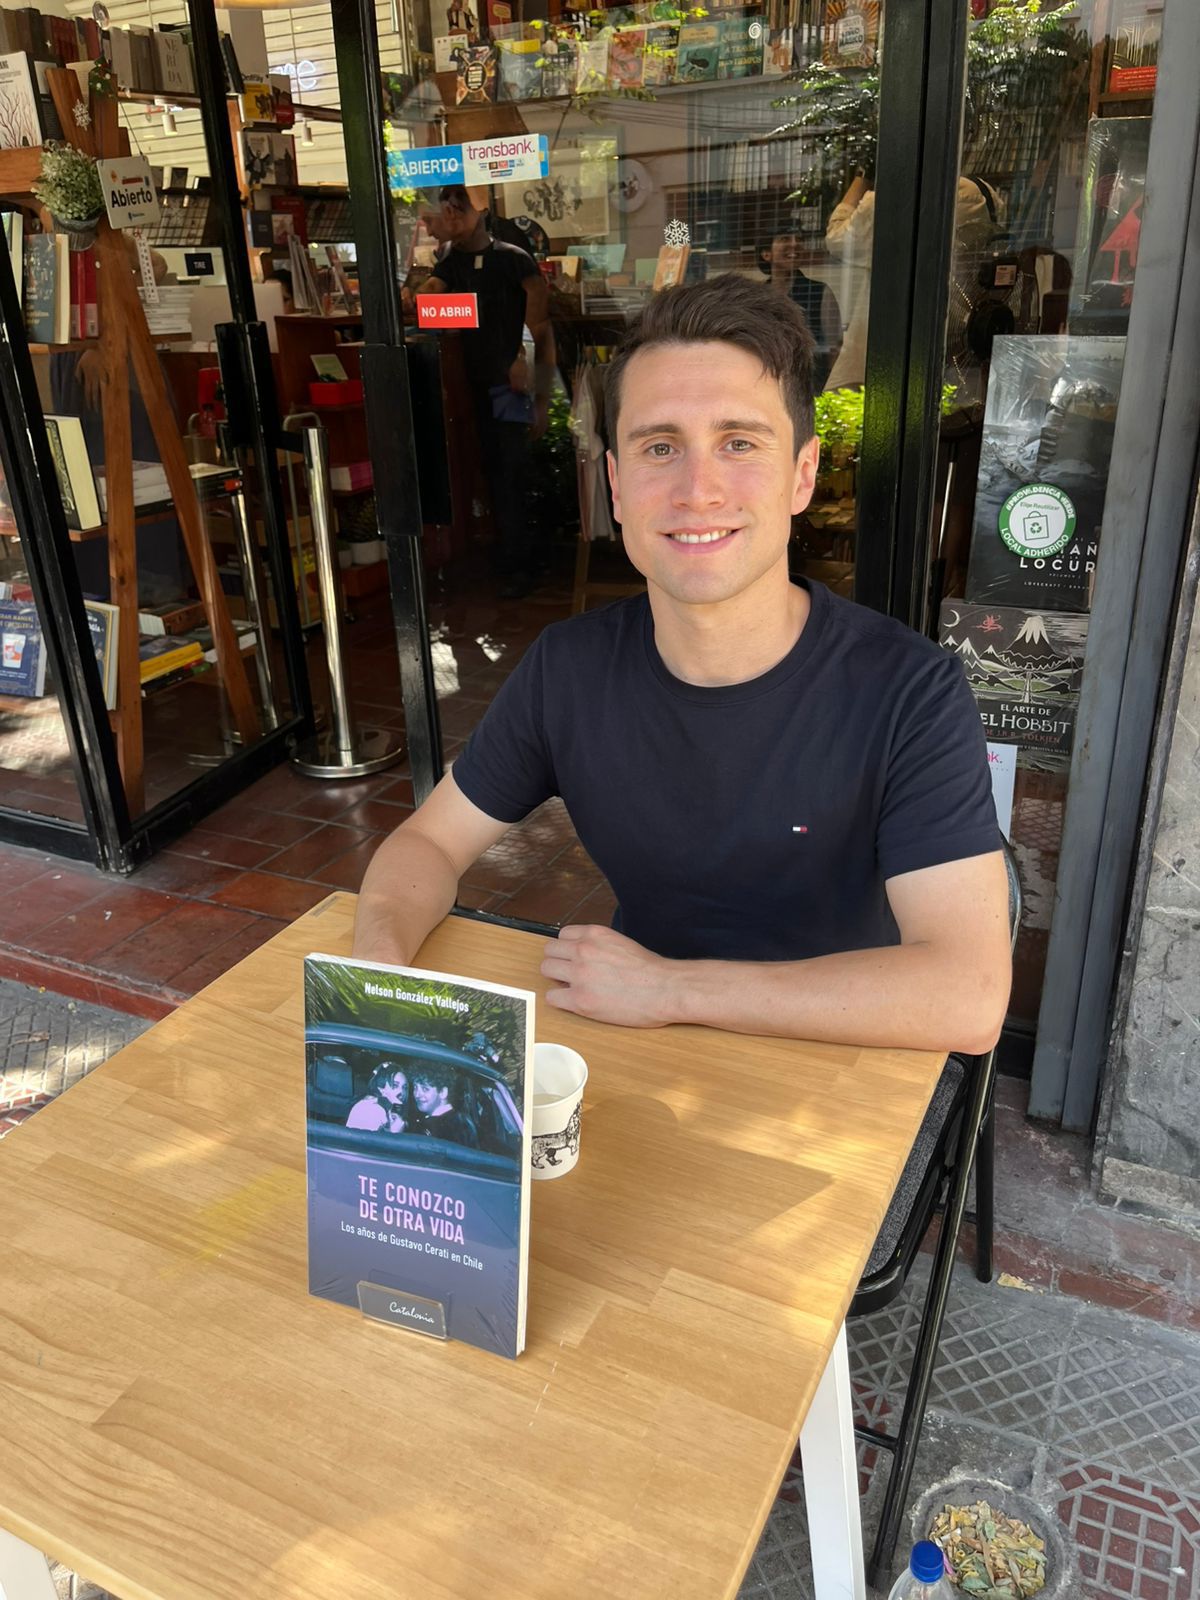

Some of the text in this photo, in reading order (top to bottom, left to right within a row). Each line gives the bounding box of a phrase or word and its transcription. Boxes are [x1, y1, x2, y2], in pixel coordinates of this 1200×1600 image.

[466, 138, 536, 161] transbank.
[400, 157, 459, 177] ABIERTO
[111, 188, 153, 209] Abierto
[421, 306, 473, 318] NO ABRIR
[1000, 527, 1069, 557] LOCAL ADHERIDO
[1020, 557, 1096, 573] LOCUR
[1000, 703, 1052, 716] EL ARTE DE
[980, 712, 1072, 734] EL HOBBIT
[364, 982, 470, 1013] Nelson González Vallejos
[358, 1175, 465, 1220] TE CONOZCO
[360, 1199, 465, 1245] DE OTRA VIDA
[341, 1220, 483, 1271] Los años de Gustavo Cerati en Chile
[389, 1301, 435, 1324] Catalonia
